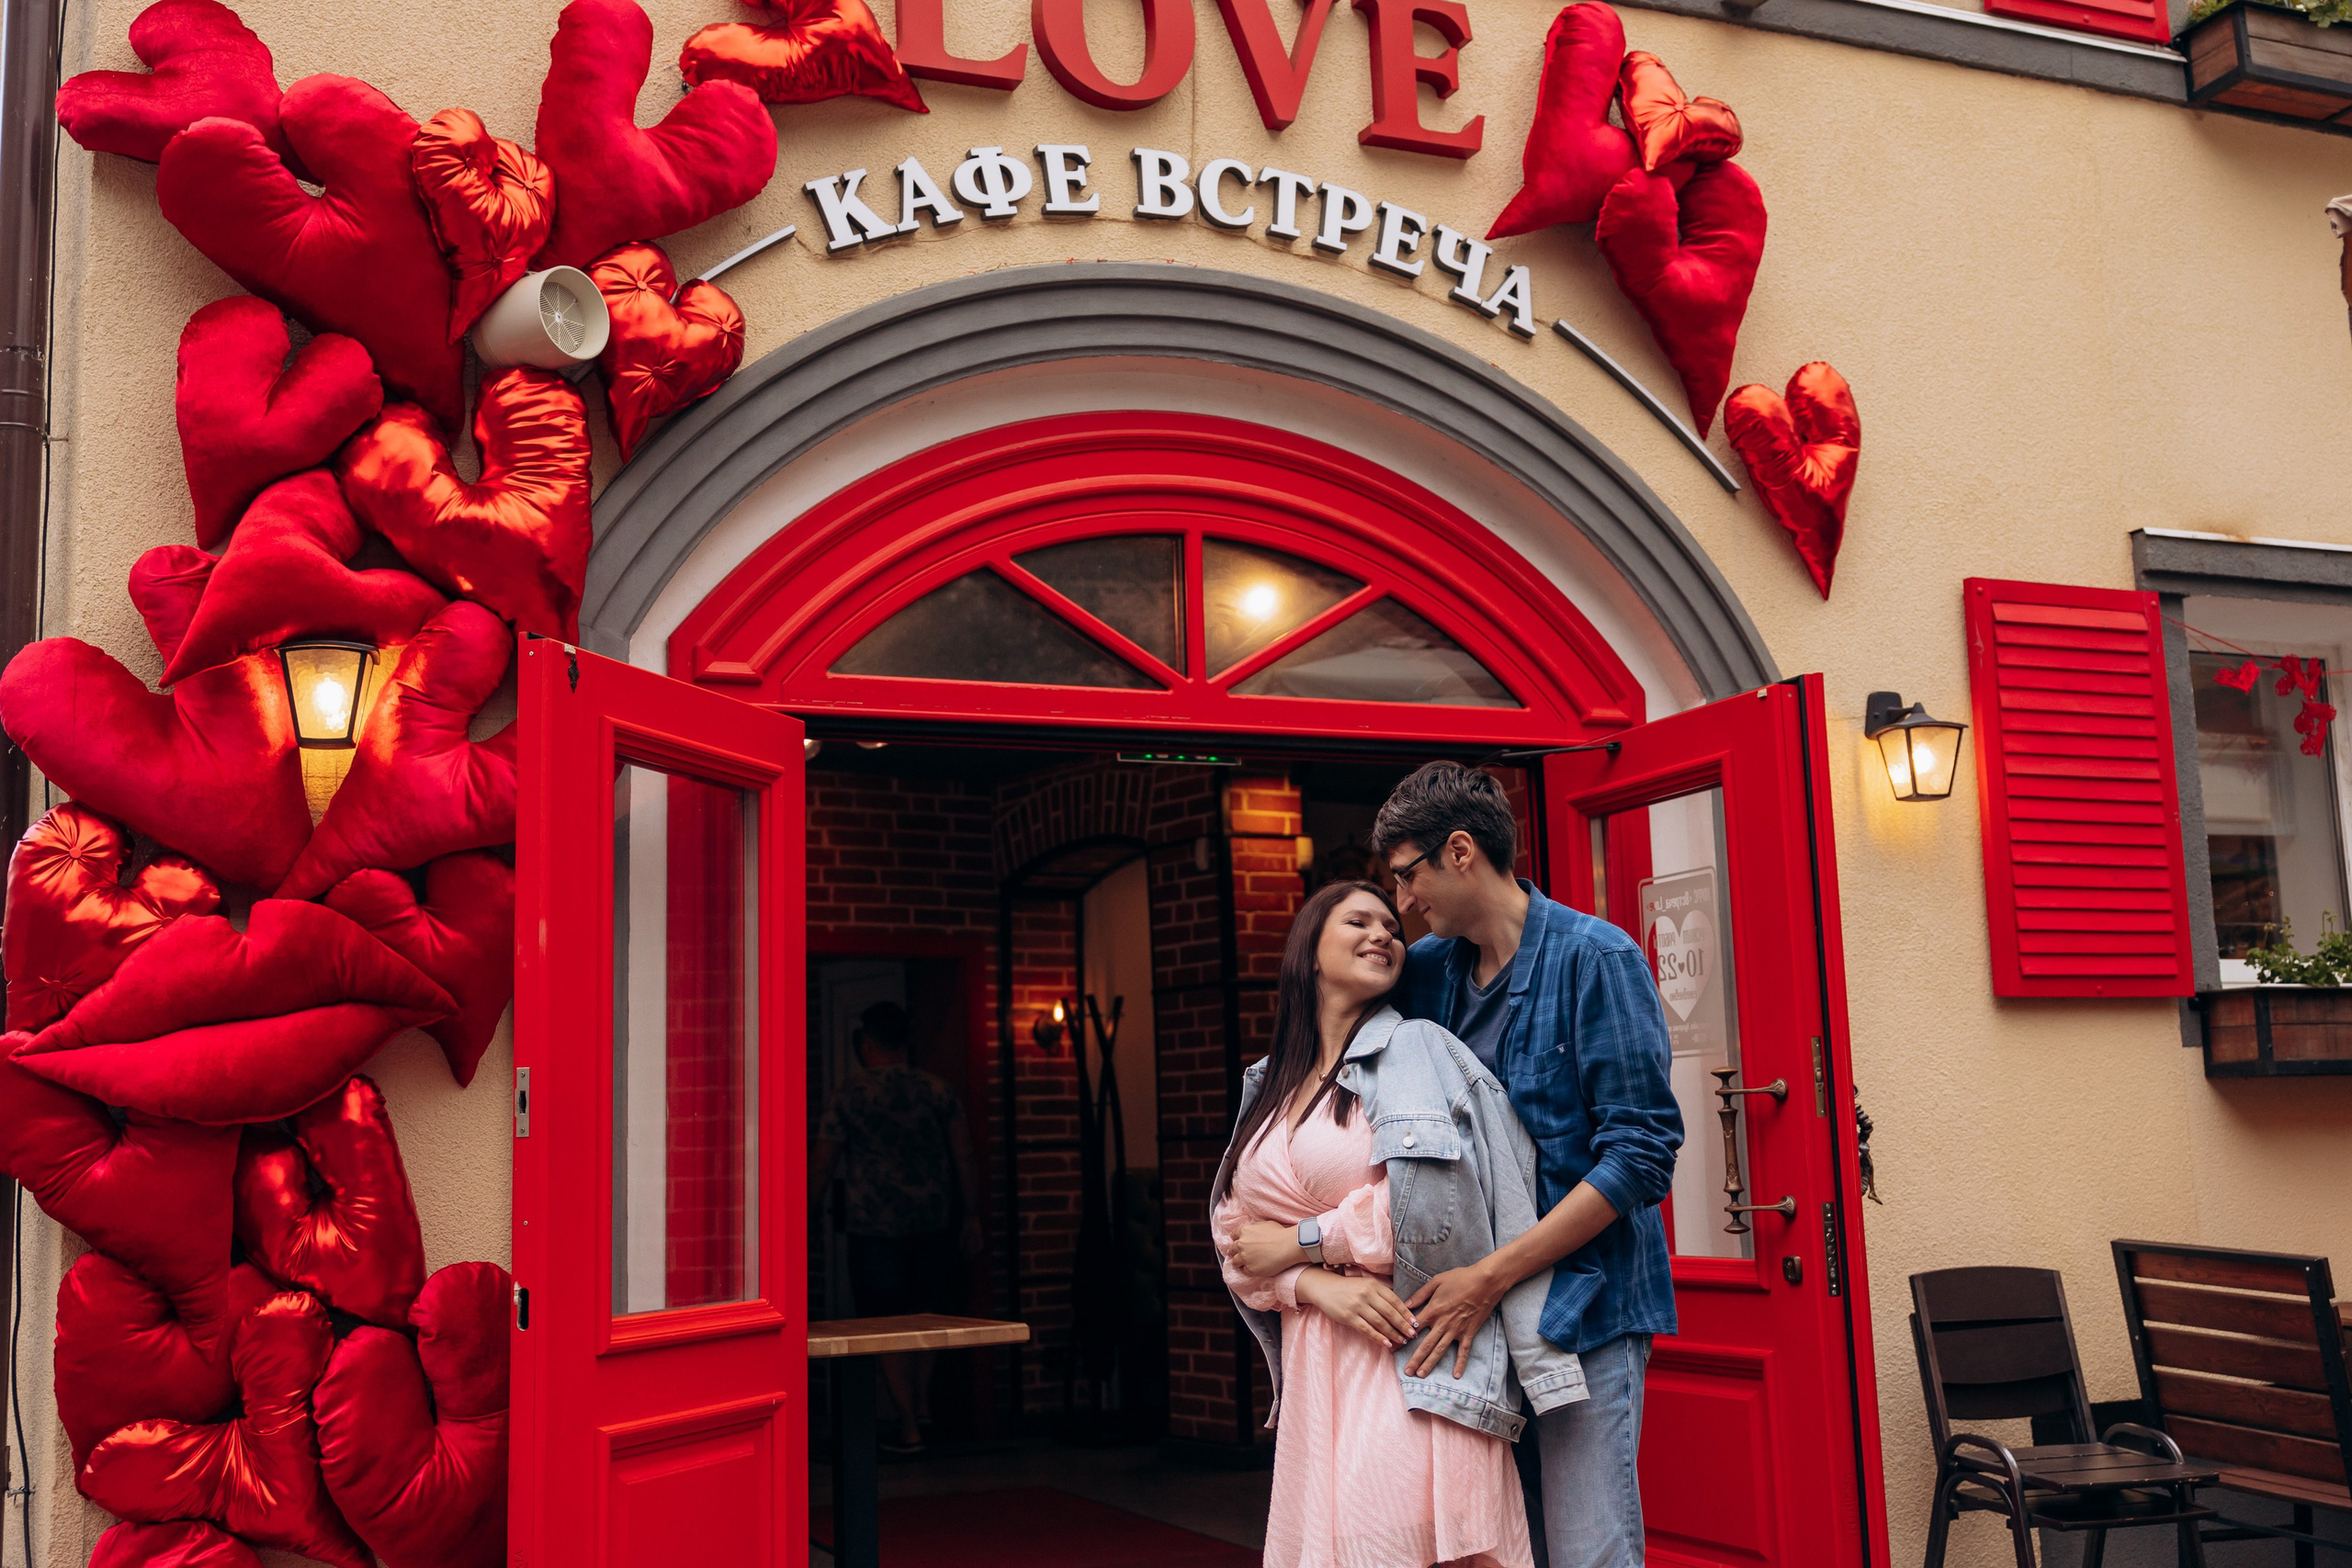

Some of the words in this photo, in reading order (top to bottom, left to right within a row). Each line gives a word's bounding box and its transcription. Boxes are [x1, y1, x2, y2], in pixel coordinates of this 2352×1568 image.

[892, 0, 1486, 160] LOVE
[803, 144, 1101, 254] КАФЕ
[1132, 147, 1537, 340] ВСТРЕЧА
